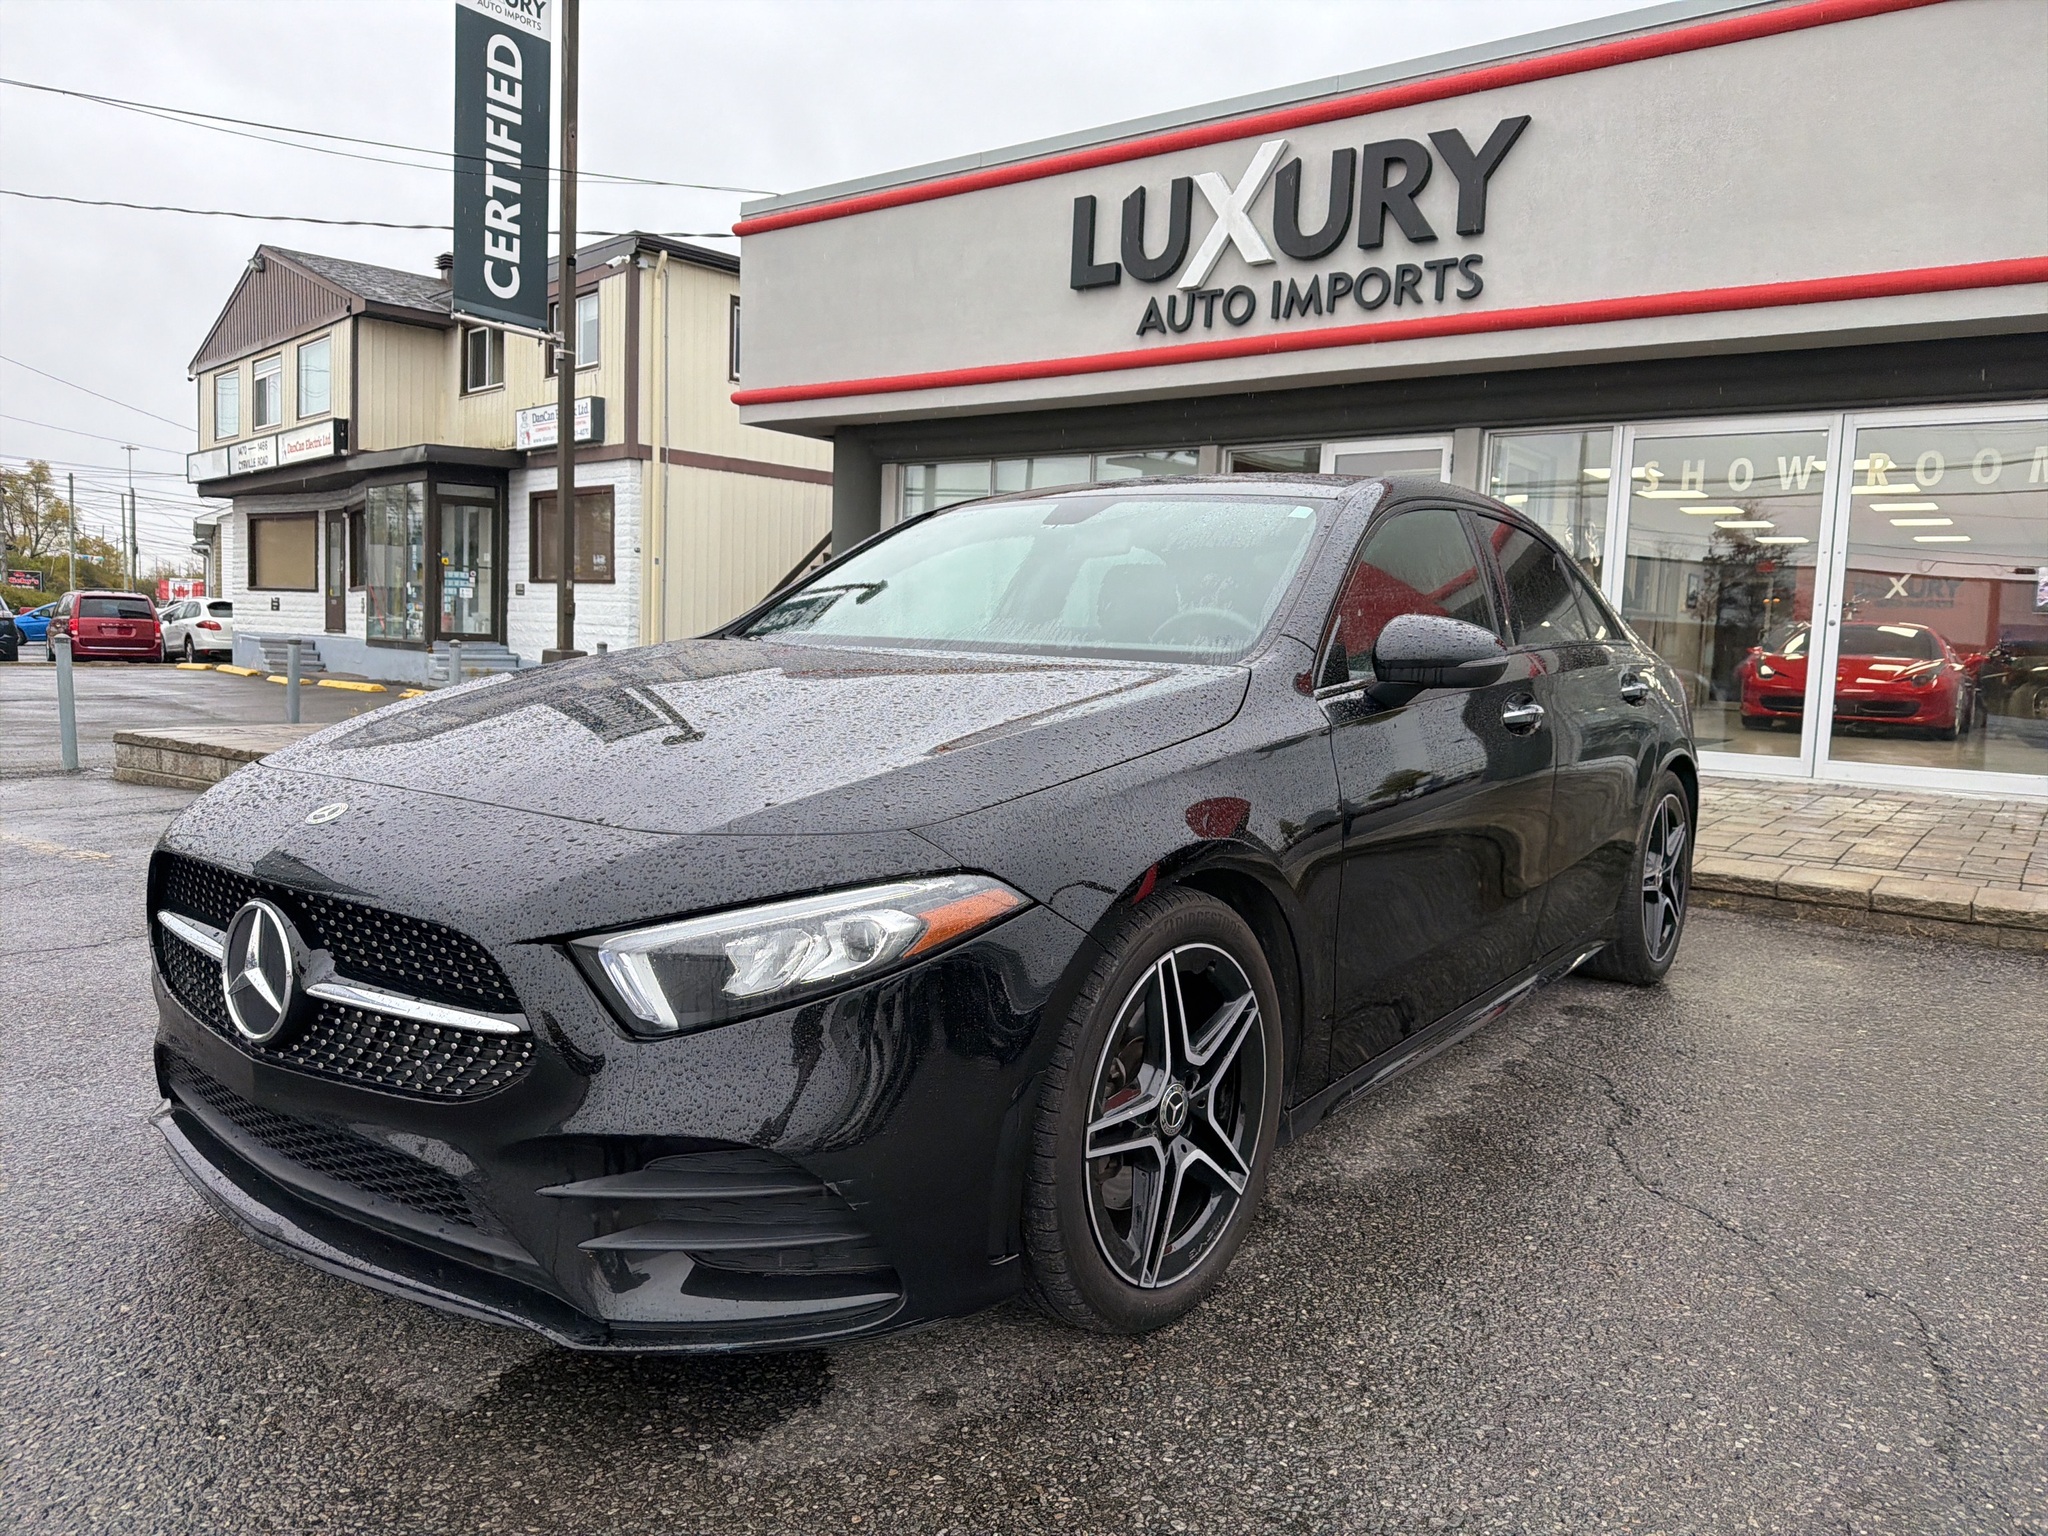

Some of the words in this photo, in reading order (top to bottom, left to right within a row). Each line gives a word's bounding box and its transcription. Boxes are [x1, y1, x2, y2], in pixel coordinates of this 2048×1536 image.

[477, 0, 502, 14] AUTO
[504, 8, 542, 31] IMPORTS
[484, 33, 523, 300] CERTIFIED
[1070, 115, 1532, 291] LUXURY
[1136, 284, 1256, 336] AUTO
[1271, 254, 1484, 320] IMPORTS
[532, 411, 555, 423] DanCan
[258, 455, 269, 466] ROAD
[287, 441, 304, 454] DanCan
[306, 436, 322, 450] Electric
[1642, 455, 1816, 492] SHOW
